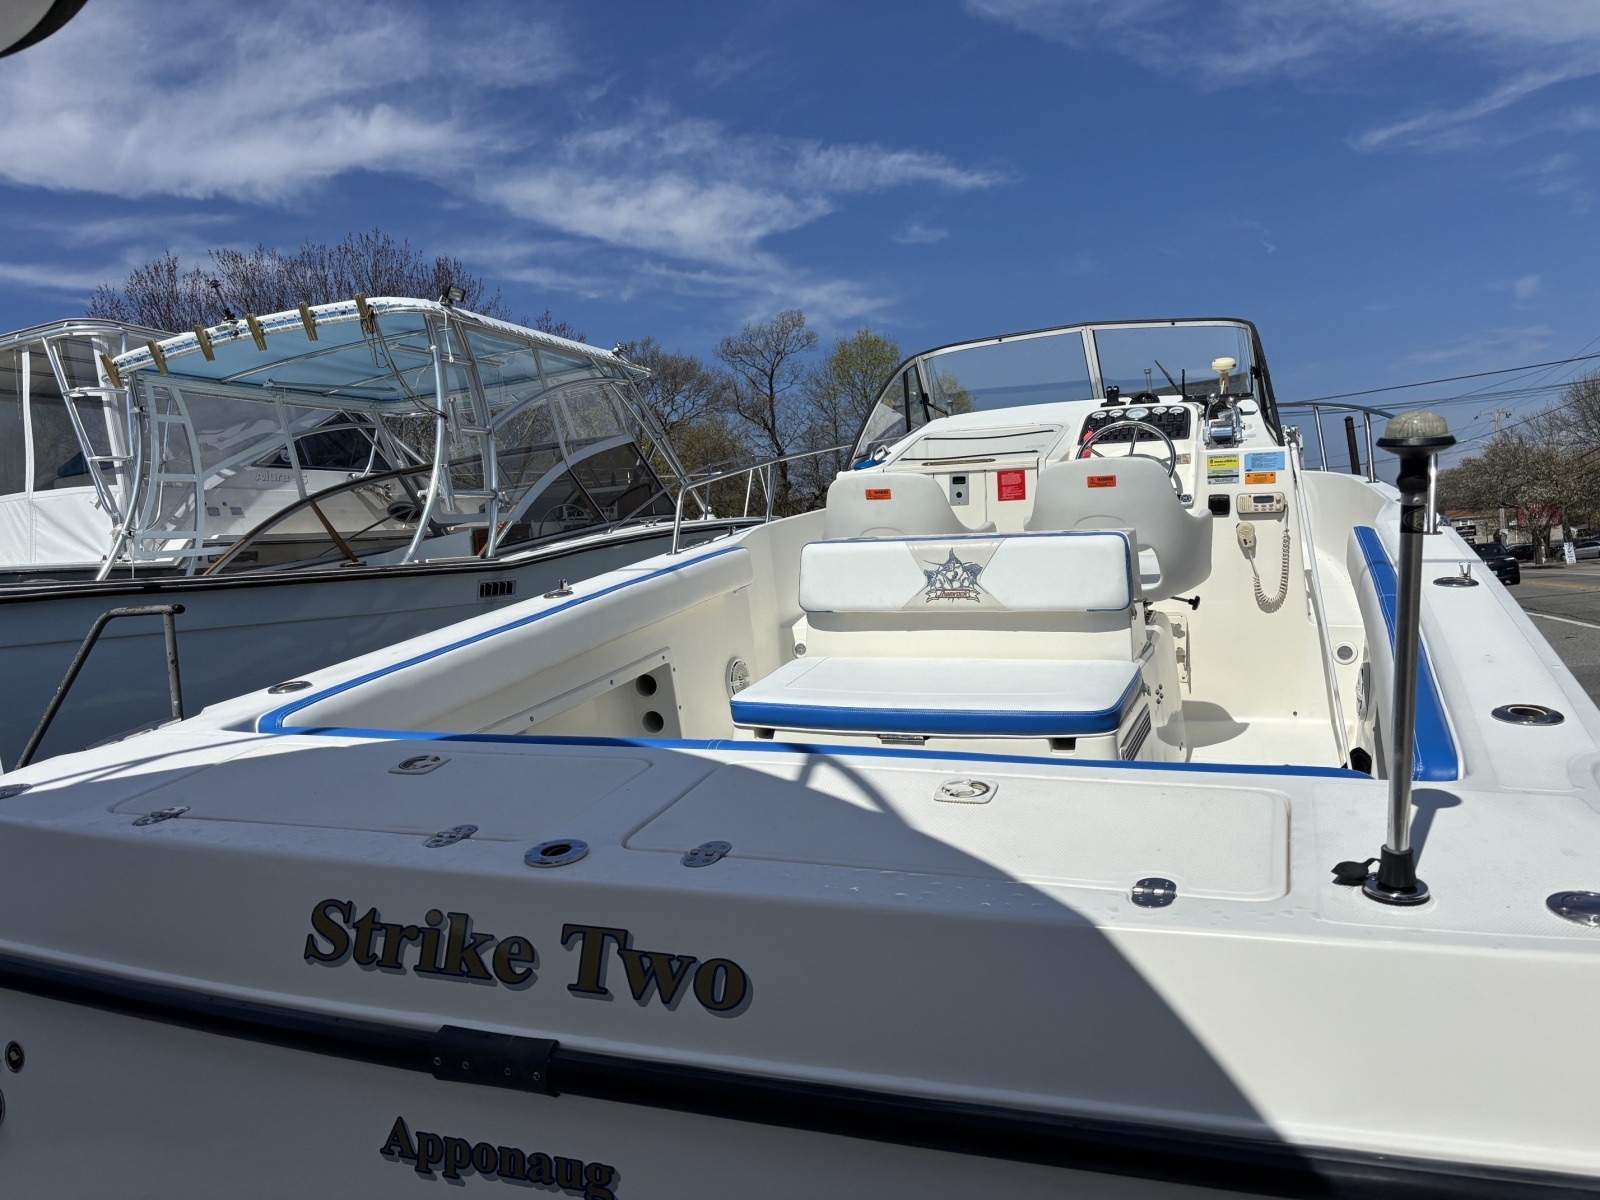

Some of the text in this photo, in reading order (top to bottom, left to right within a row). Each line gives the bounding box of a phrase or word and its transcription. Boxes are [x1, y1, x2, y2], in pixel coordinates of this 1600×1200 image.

[255, 469, 290, 483] Alura
[303, 898, 752, 1017] Strike Two
[379, 1115, 619, 1200] Apponaug
